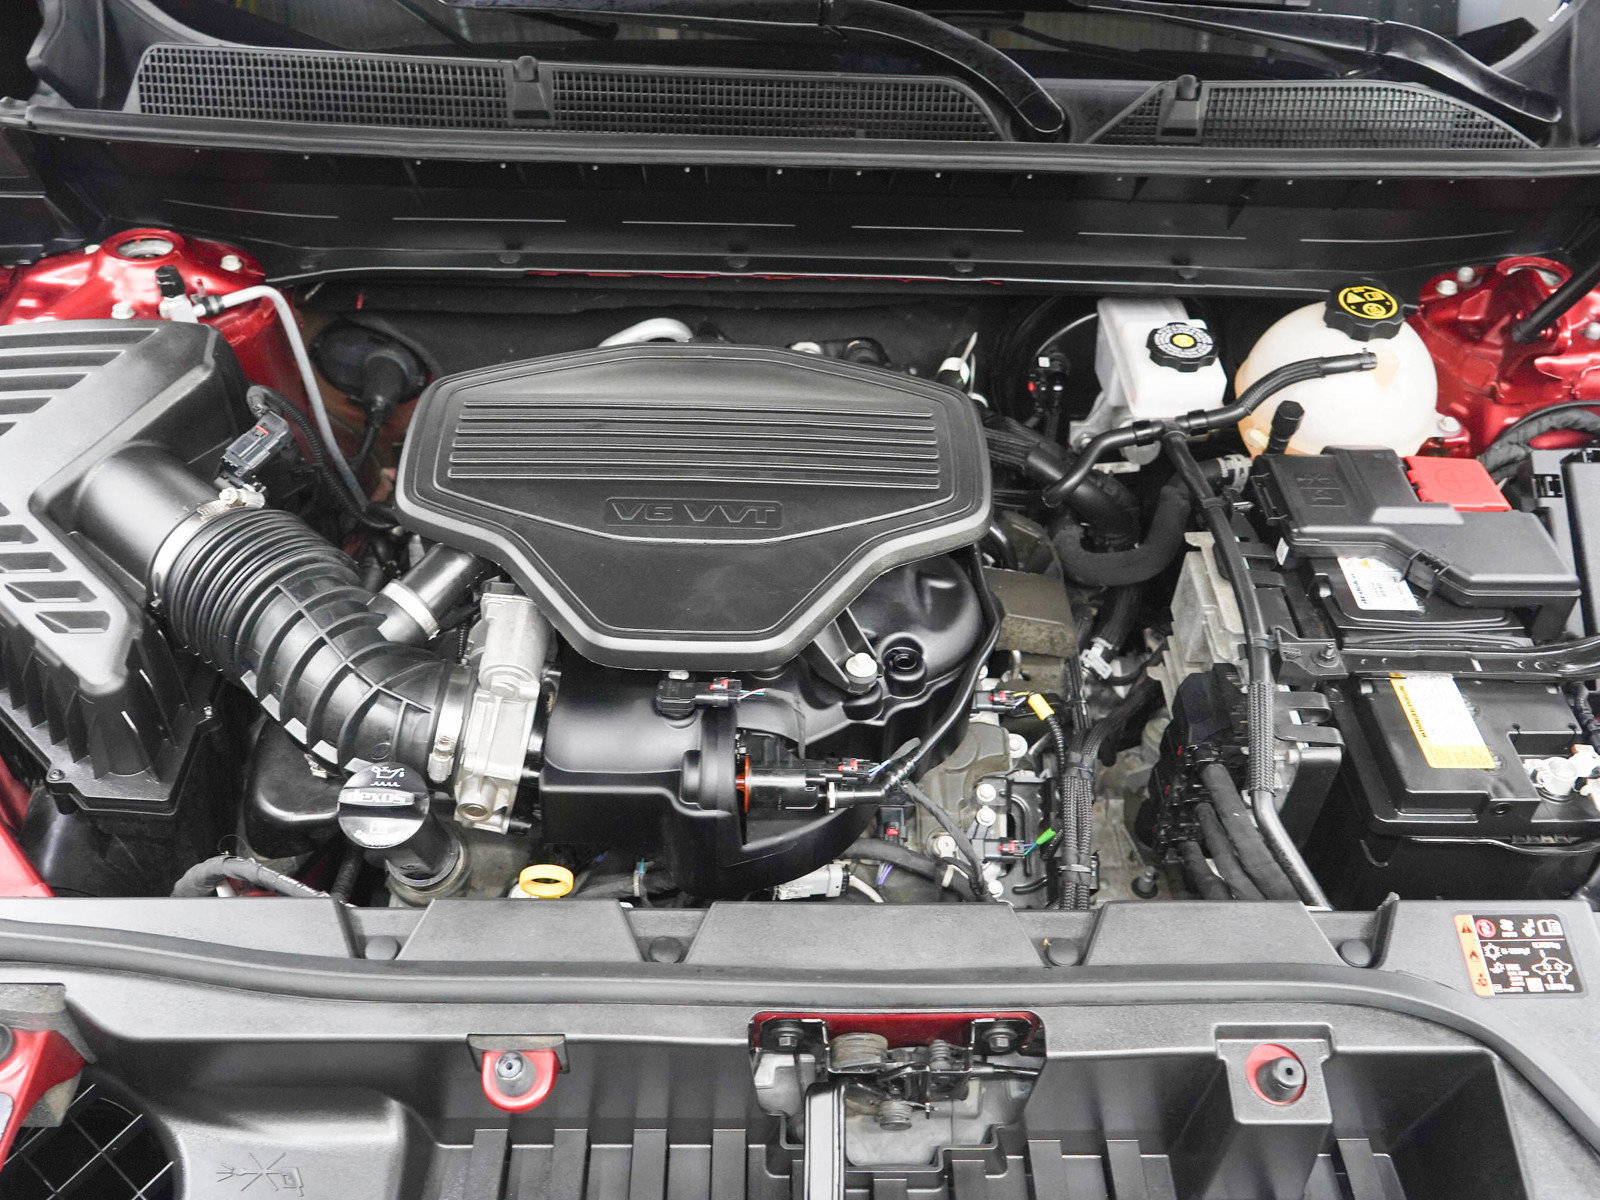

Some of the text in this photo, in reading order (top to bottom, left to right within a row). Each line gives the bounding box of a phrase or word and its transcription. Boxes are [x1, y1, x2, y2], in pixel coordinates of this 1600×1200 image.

[611, 502, 777, 524] V6 VVT
[345, 788, 406, 804] dexos
